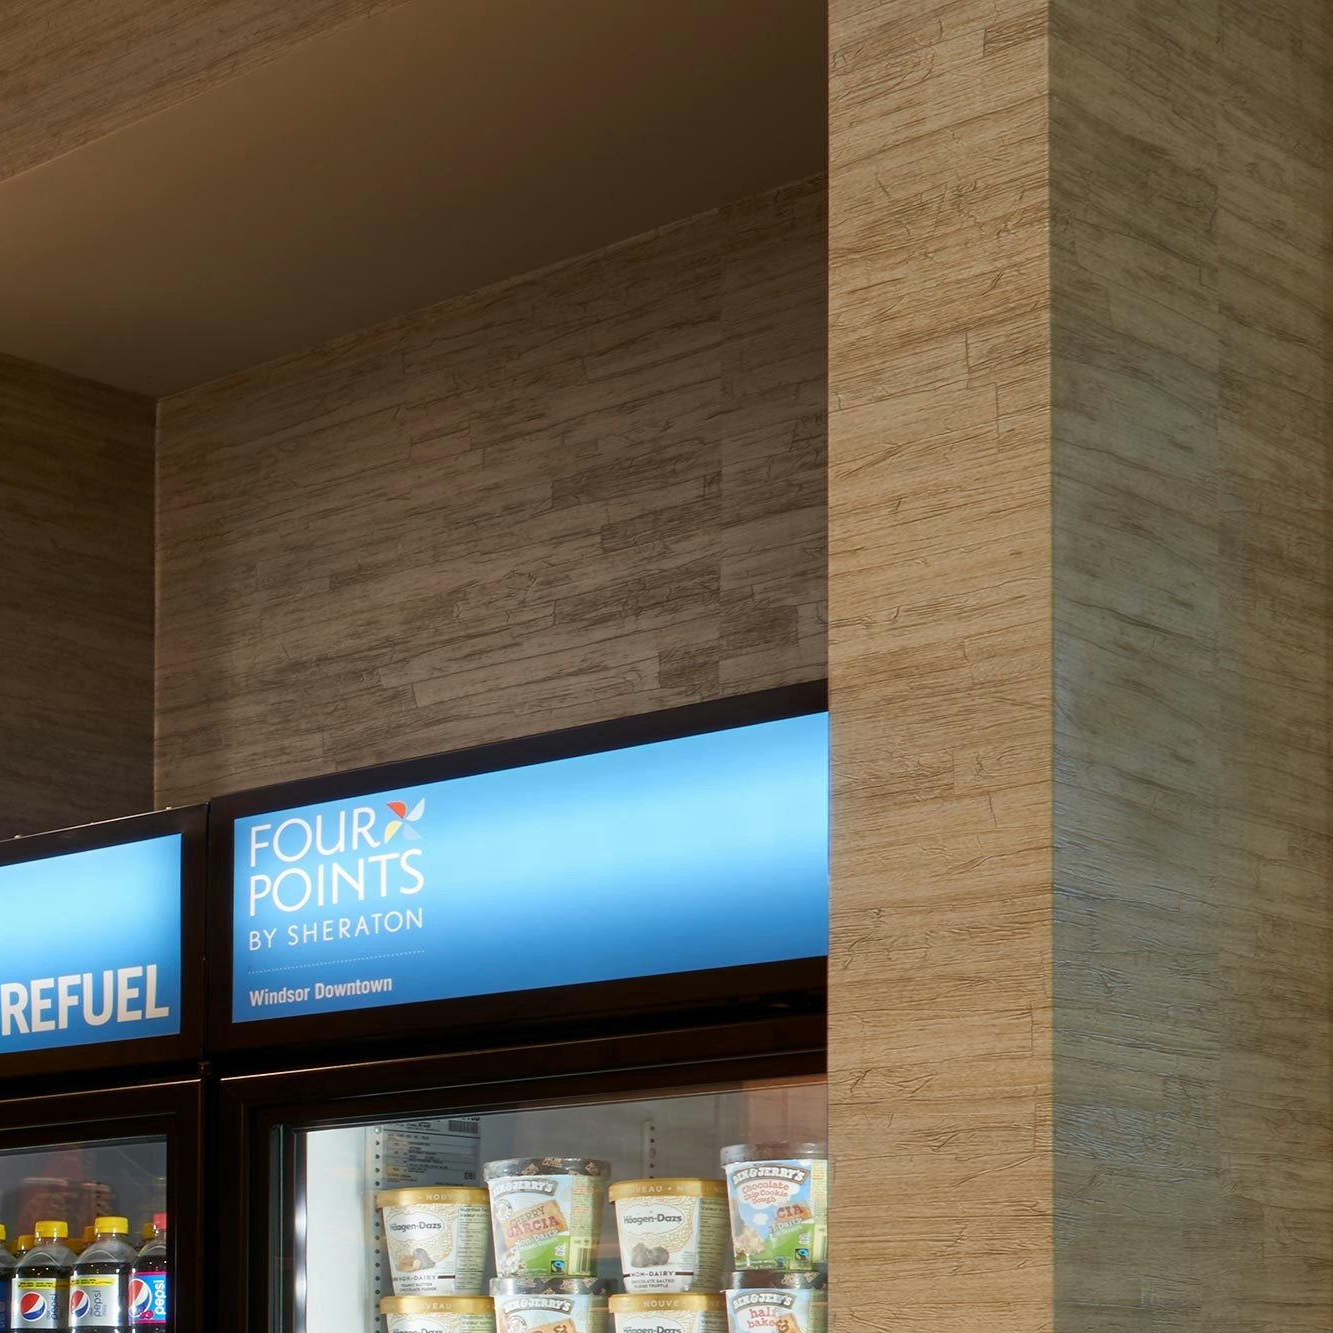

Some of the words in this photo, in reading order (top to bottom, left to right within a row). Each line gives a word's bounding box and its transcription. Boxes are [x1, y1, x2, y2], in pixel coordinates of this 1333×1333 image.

[249, 806, 381, 867] FOUR
[249, 848, 425, 917] POINTS
[249, 928, 278, 951] BY
[287, 907, 423, 946] SHERATON
[0, 963, 170, 1036] REFUEL
[249, 986, 310, 1007] Windsor
[314, 977, 393, 1000] Downtown
[741, 1180, 790, 1194] Chocolate
[507, 1216, 560, 1239] GARCIA
[154, 1279, 166, 1316] pepsi
[749, 1307, 778, 1319] half
